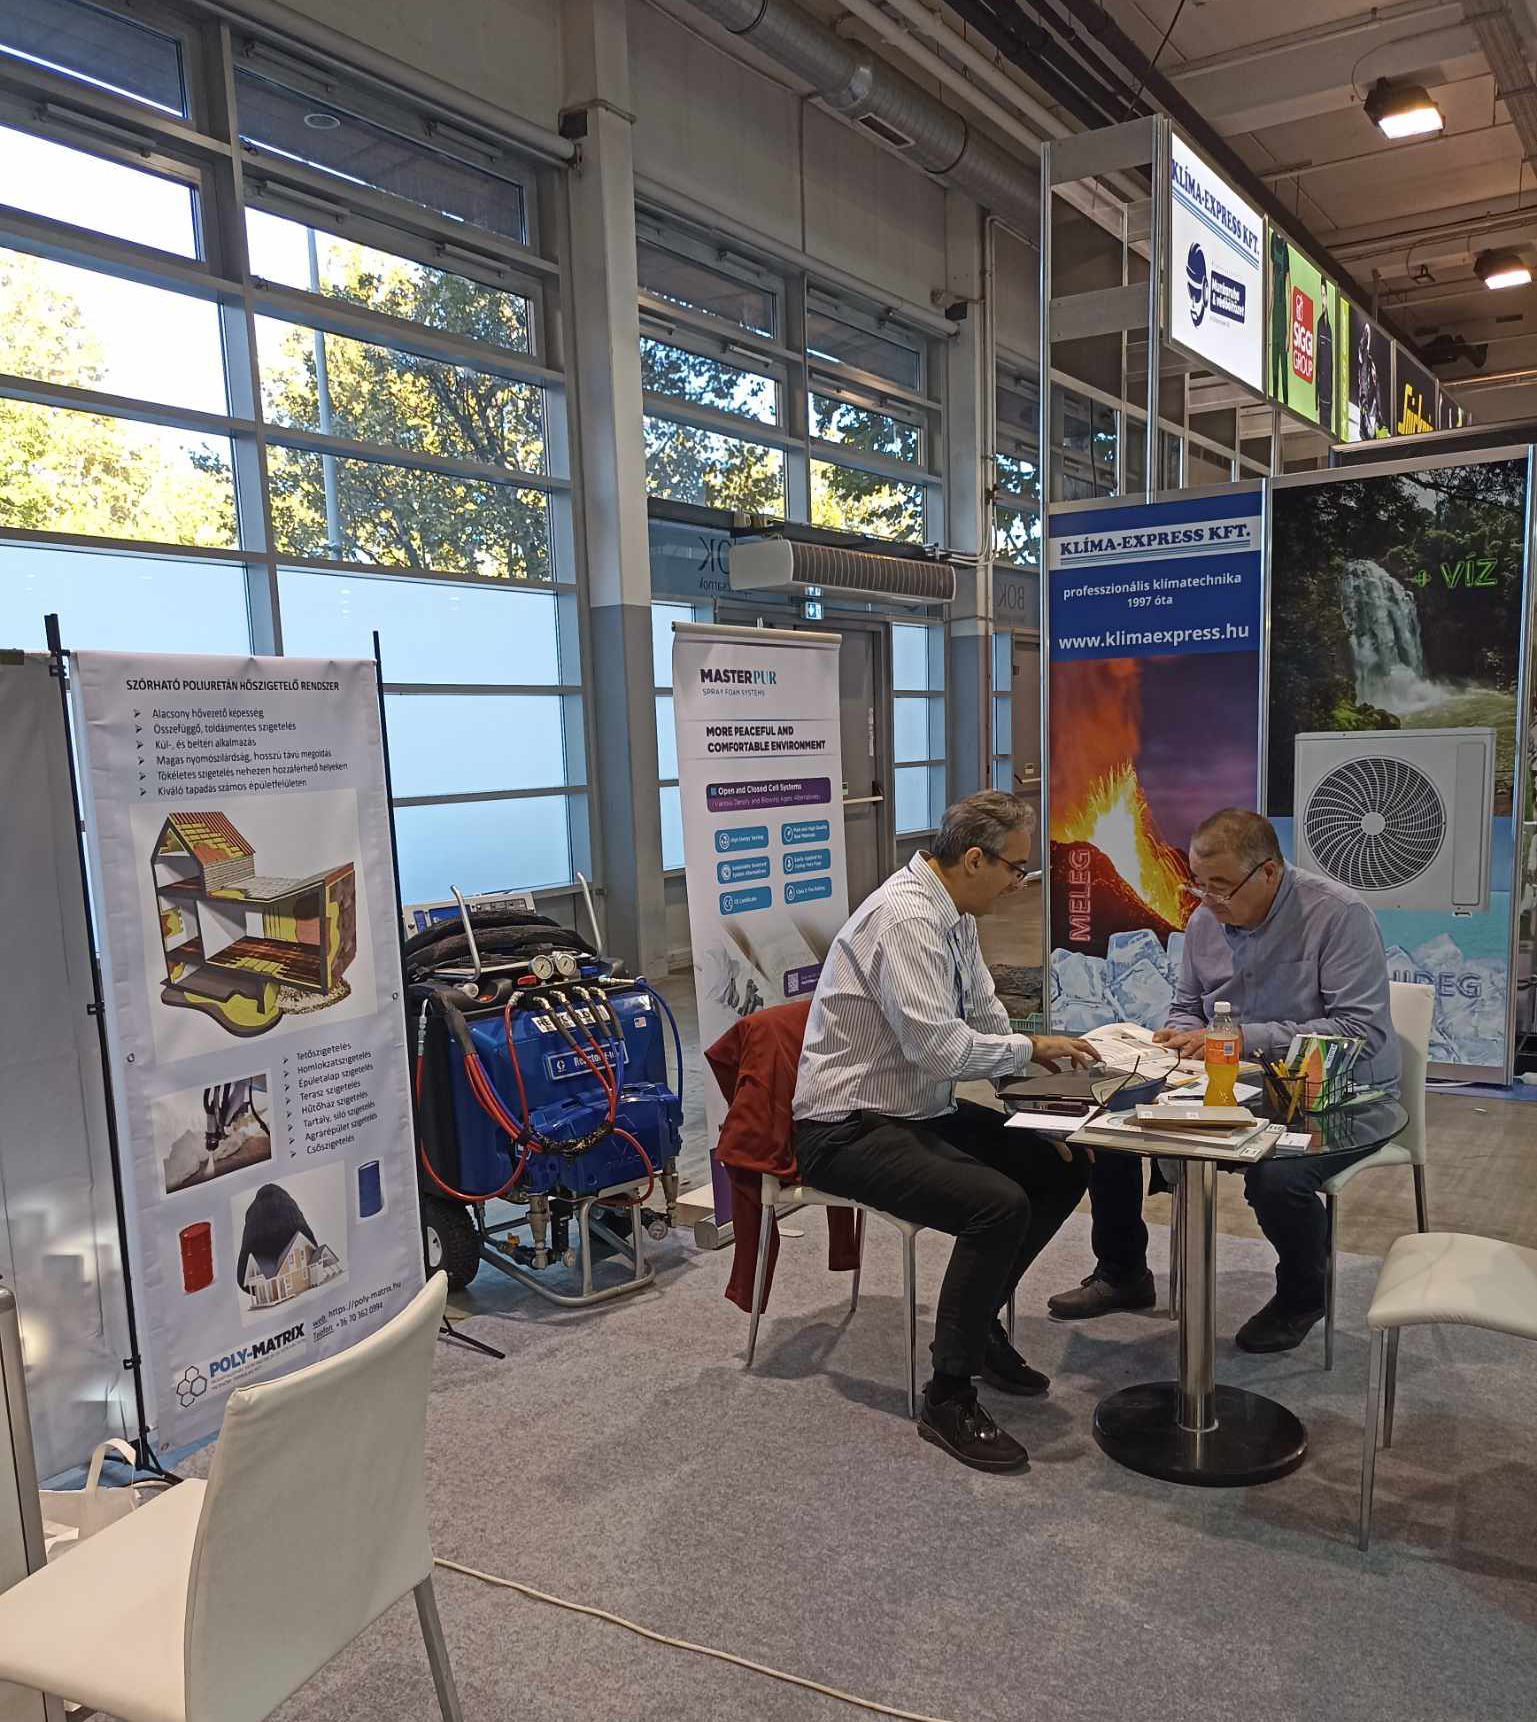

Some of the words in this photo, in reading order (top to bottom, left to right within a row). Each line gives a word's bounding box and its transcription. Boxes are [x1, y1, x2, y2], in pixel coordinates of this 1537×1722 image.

[1172, 158, 1242, 239] KLÍMA-EXPRESS
[1242, 224, 1260, 256] KFT.
[1294, 349, 1313, 378] GROUP
[1060, 527, 1204, 556] KLÍMA-EXPRESS
[1208, 523, 1250, 541] KFT.
[1440, 551, 1498, 589] VÍZ
[1064, 580, 1150, 600] professzionális
[1153, 572, 1242, 591] klímatechnika
[1127, 596, 1152, 608] 1997
[1154, 595, 1173, 607] óta
[1059, 622, 1249, 650] www.klimaexpress.hu
[126, 677, 180, 691] SZÓRHATÓ
[183, 678, 238, 691] POLIURETÁN
[240, 678, 299, 691] HŐSZIGETELŐ
[301, 681, 340, 691] RENDSZER
[700, 668, 777, 685] MASTERPUR
[702, 688, 724, 697] SPRAY
[724, 689, 741, 697] FOAM
[741, 689, 766, 697] SYSTEMS
[152, 708, 190, 720] Alacsony
[258, 721, 297, 733] szigetelés
[706, 726, 733, 737] MORE
[734, 725, 776, 737] PEACEFUL
[777, 725, 794, 736] AND
[708, 740, 770, 753] COMFORTABLE
[770, 740, 826, 751] ENVIRONMENT
[156, 755, 185, 767] Magas
[198, 768, 235, 780] szigetelés
[718, 787, 735, 797] Open
[735, 785, 746, 795] and
[1068, 849, 1091, 941] MELEG
[297, 1043, 352, 1059] Tetőszigetelés
[298, 1052, 372, 1073] Homlokzatszigetelés
[341, 1063, 374, 1077] szigetelés
[300, 1091, 324, 1101] Terasz
[325, 1080, 361, 1095] szigetelés
[336, 1090, 369, 1106] szigetelés
[347, 1100, 376, 1115] szigetelés
[351, 1113, 378, 1125] szigetelés
[306, 1135, 355, 1153] Csőszigetelés
[209, 1322, 305, 1378] POLY-MATRIX
